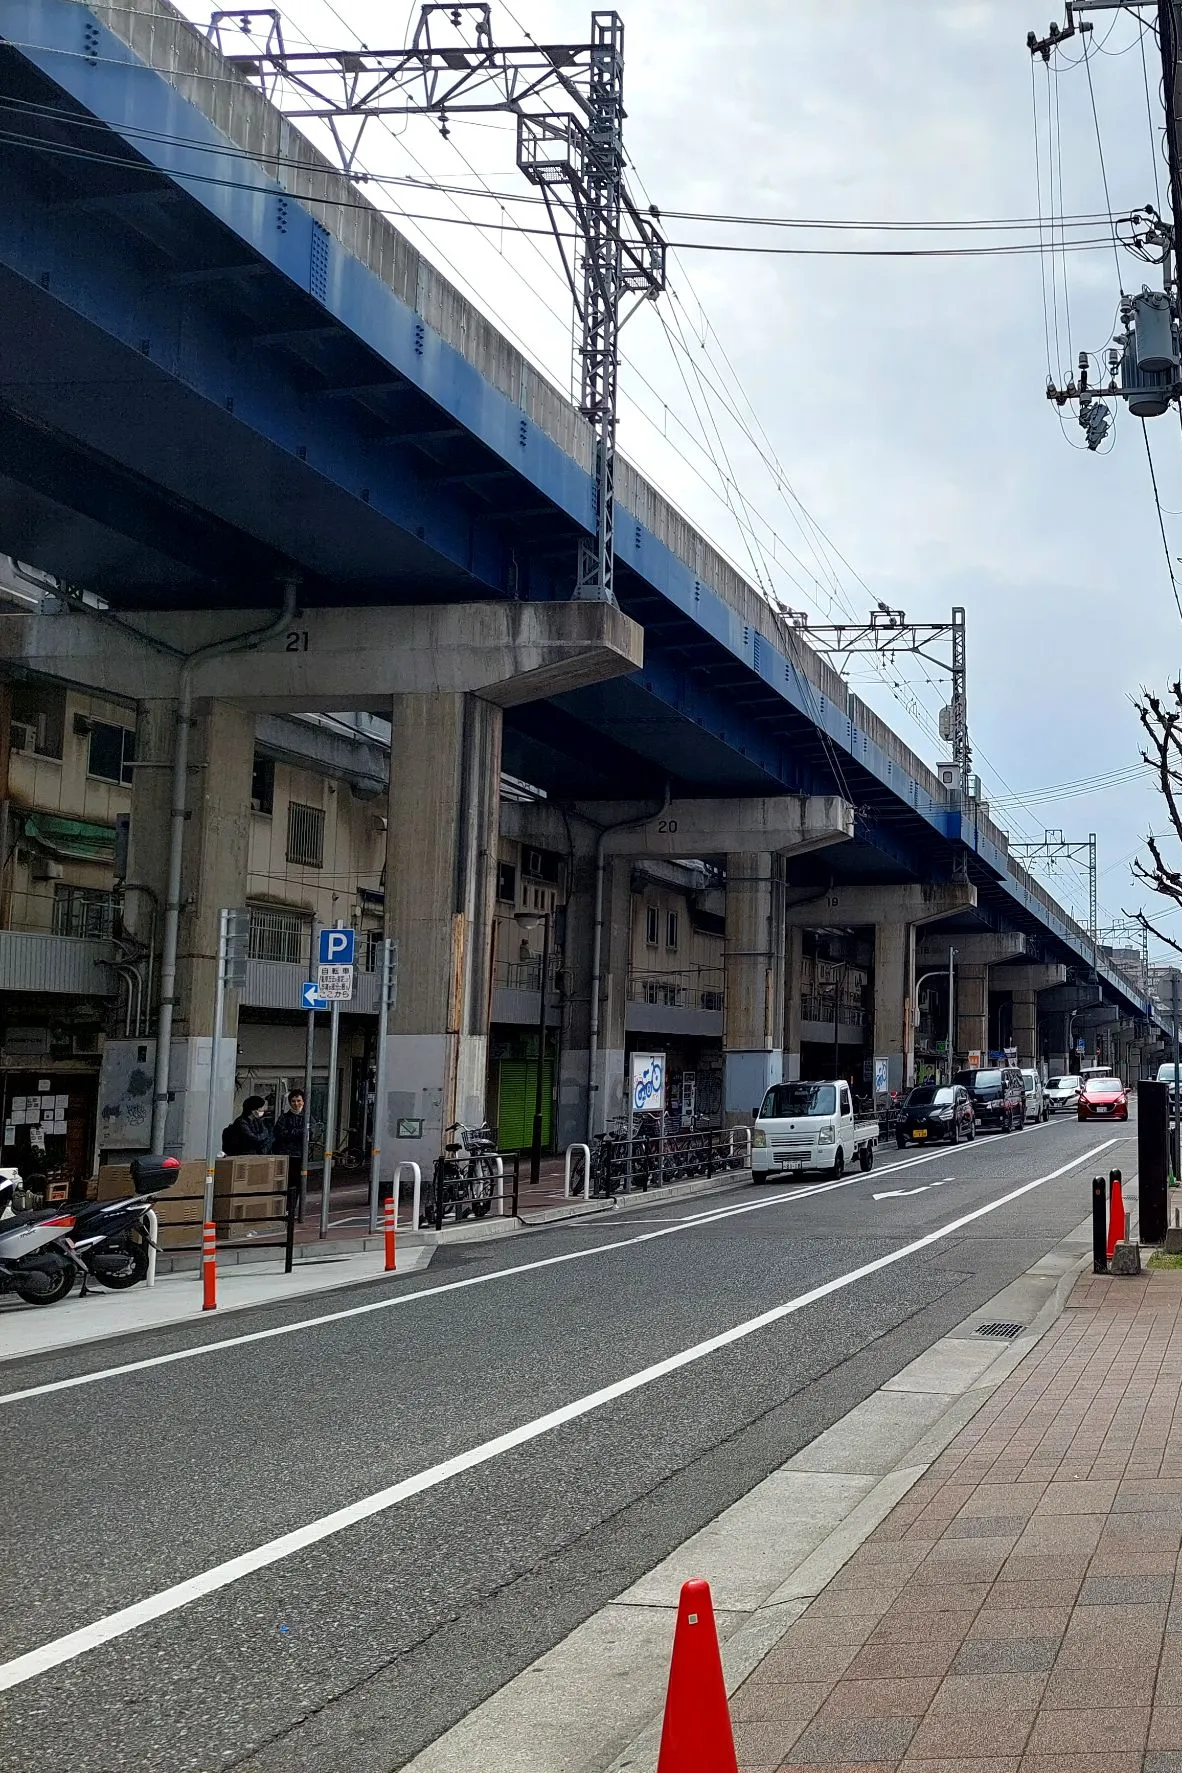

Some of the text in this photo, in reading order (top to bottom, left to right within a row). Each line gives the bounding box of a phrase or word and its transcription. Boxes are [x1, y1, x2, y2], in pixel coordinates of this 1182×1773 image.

[286, 631, 308, 652] 21
[659, 820, 677, 833] 20
[328, 933, 348, 960] P
